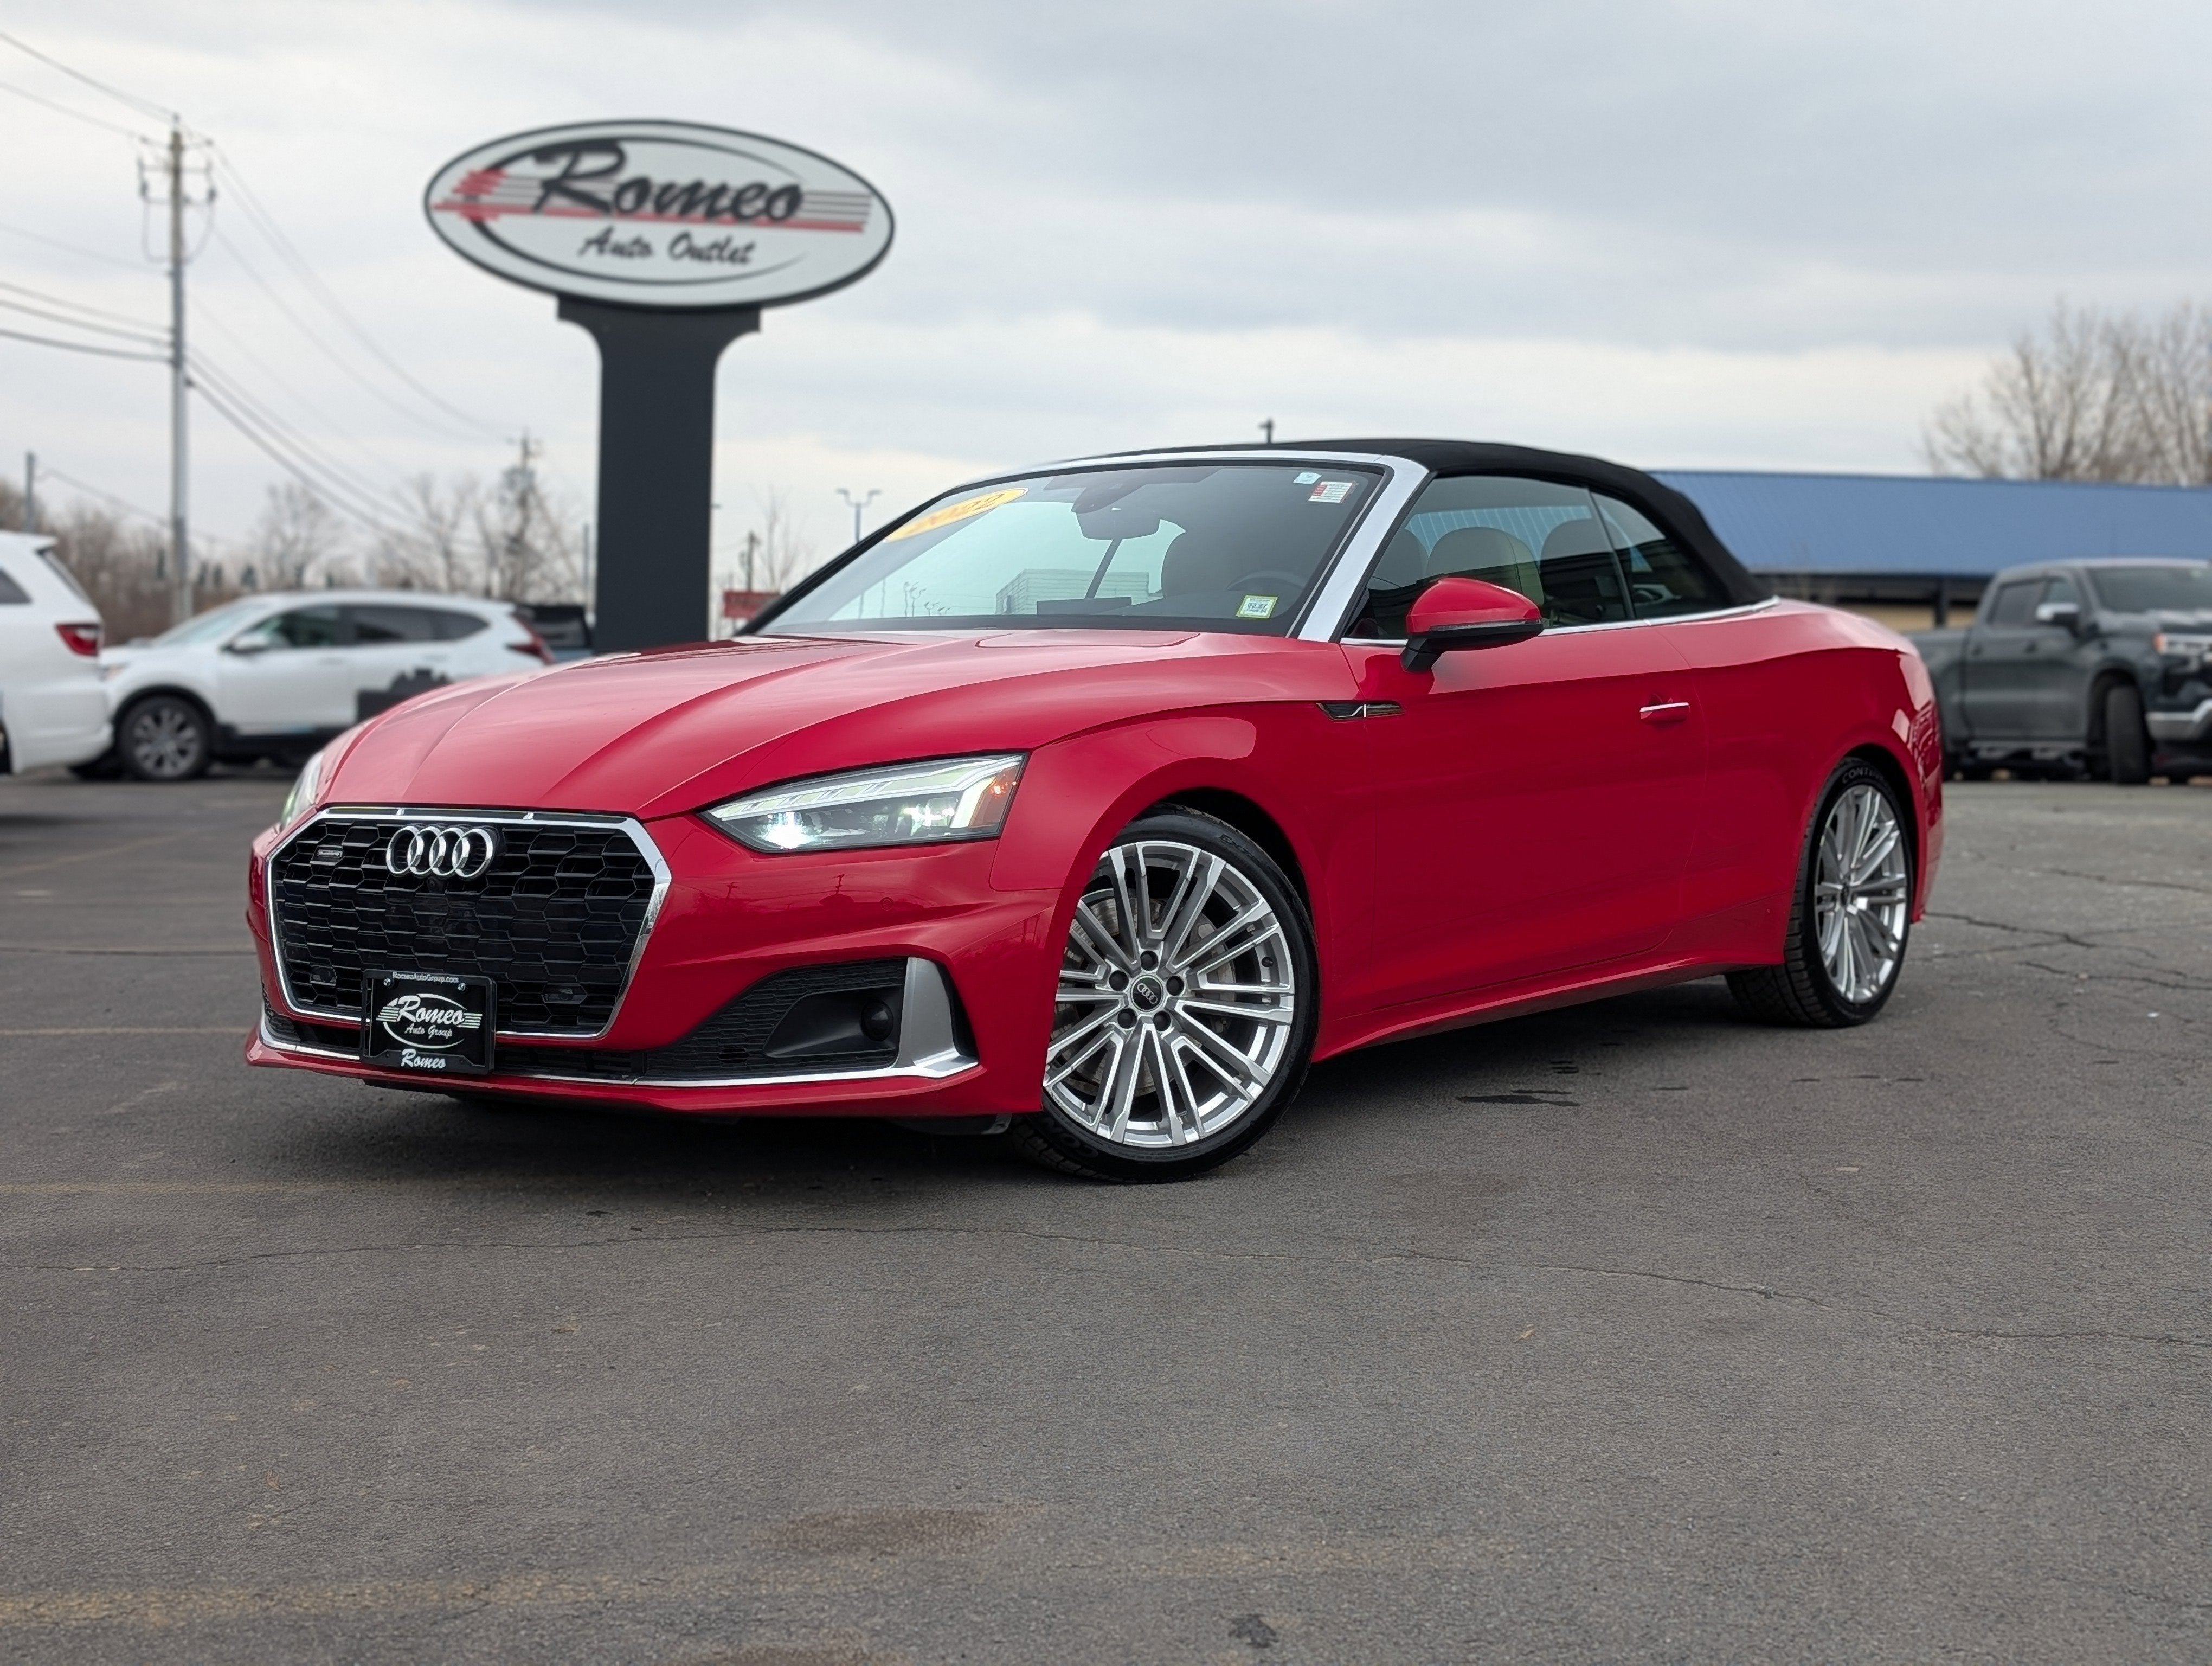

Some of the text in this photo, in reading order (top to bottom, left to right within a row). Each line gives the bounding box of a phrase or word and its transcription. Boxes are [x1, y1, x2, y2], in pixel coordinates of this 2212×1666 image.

[530, 139, 803, 222] Romeo
[577, 225, 756, 265] Auto Outlet
[392, 971, 459, 984] RomeoAutoGroup.com
[396, 995, 465, 1025] Romeo
[404, 1023, 453, 1039] Auto Group
[401, 1048, 446, 1069] Romeo
